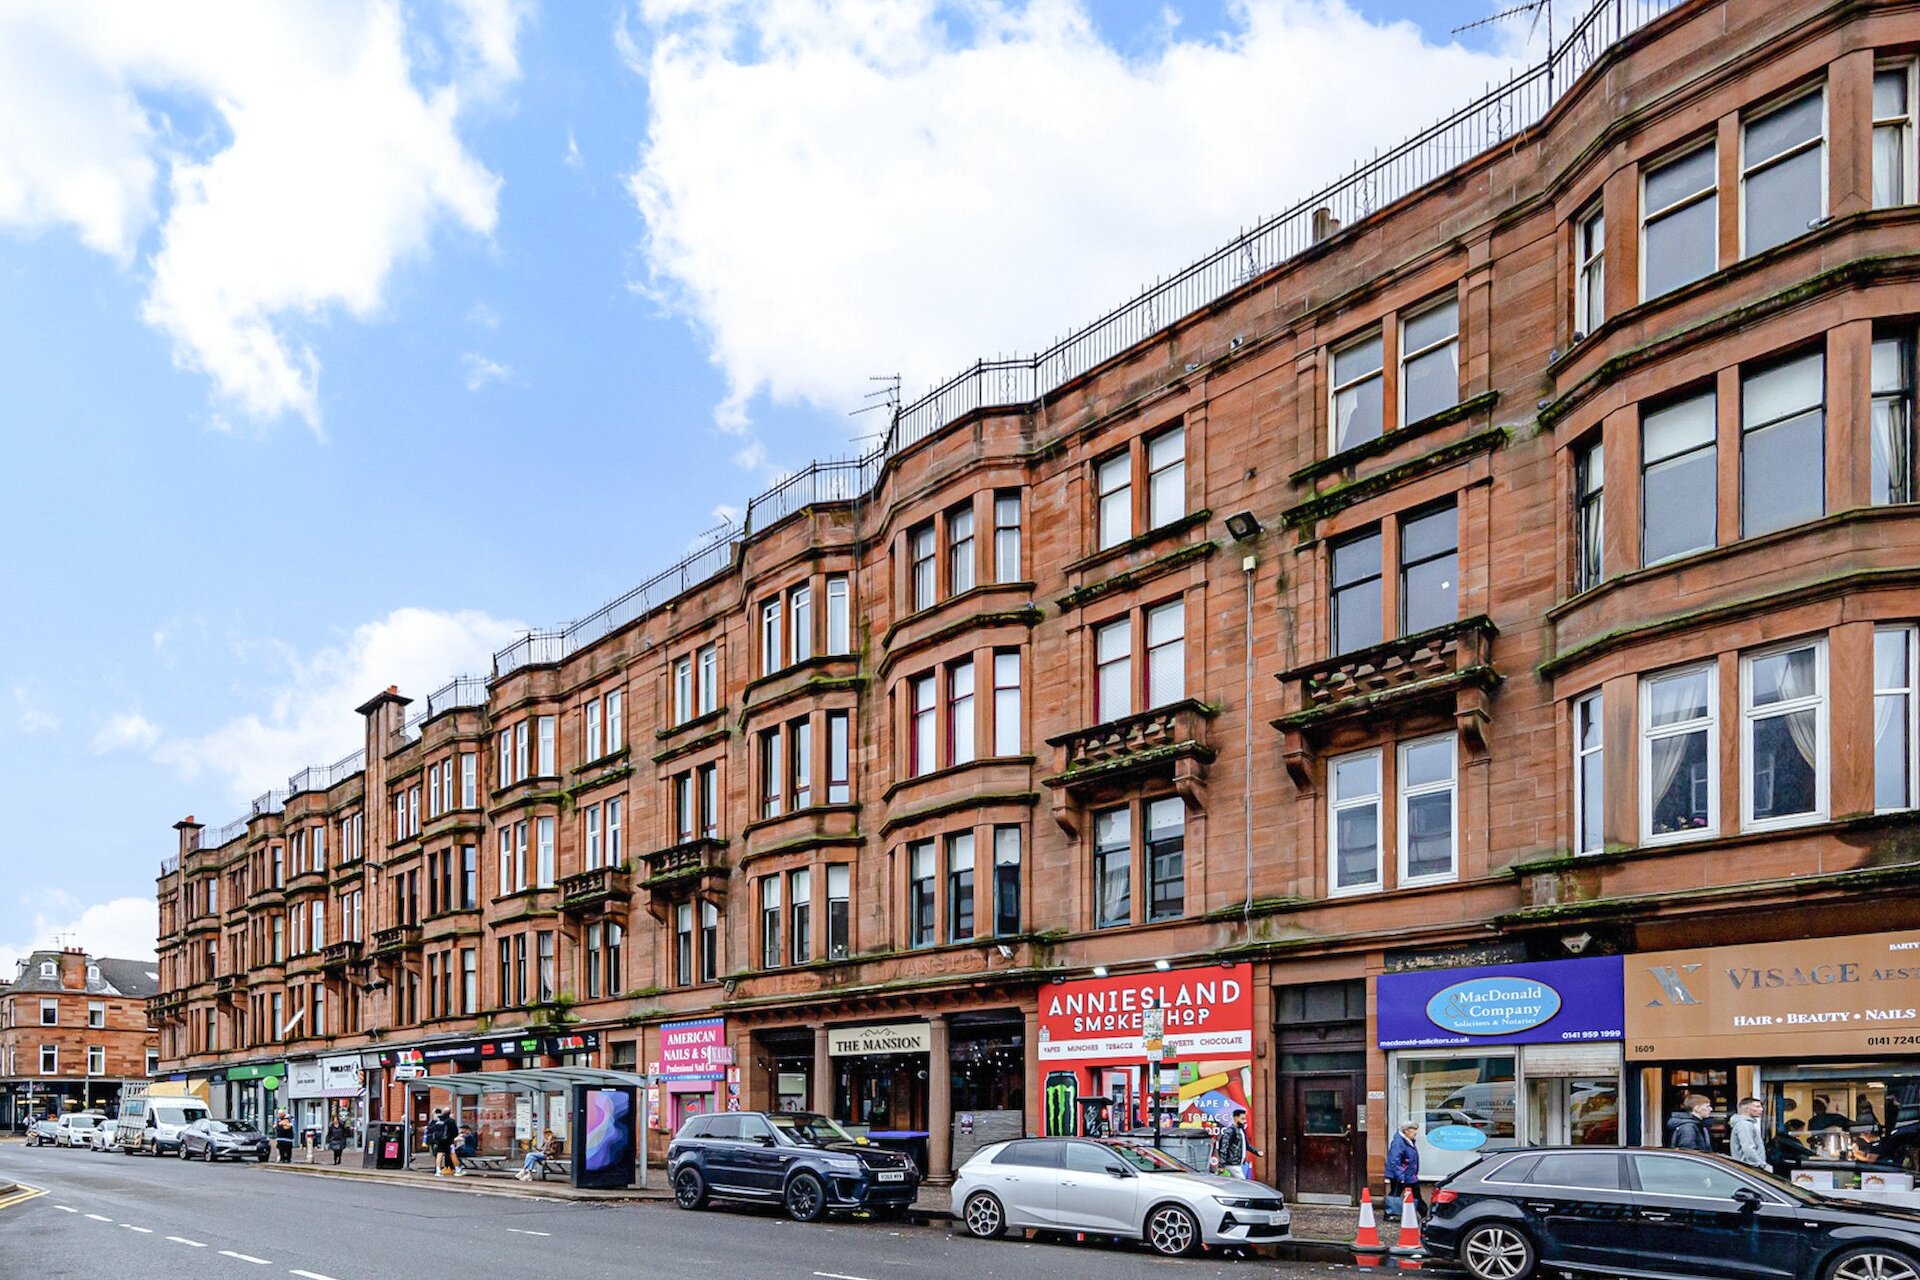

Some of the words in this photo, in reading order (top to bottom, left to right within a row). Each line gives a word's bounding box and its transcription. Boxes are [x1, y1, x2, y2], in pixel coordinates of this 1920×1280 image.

[1726, 963, 1860, 990] VISAGE
[1049, 980, 1241, 1016] ANNIESLAND
[1459, 987, 1542, 1003] MacDonald
[1469, 1005, 1541, 1018] Company
[1733, 1015, 1772, 1026] HAIR
[1786, 1012, 1850, 1024] BEAUTY
[1865, 1009, 1917, 1021] NAILS
[1073, 1013, 1142, 1033] SMOKE
[1167, 1008, 1211, 1026] HOP
[1453, 1020, 1490, 1028] Solicitors
[667, 1030, 716, 1045] AMERICAN
[1199, 1036, 1243, 1045] CHOCOLATE
[1562, 1031, 1581, 1040] 0141
[1582, 1030, 1599, 1039] 959
[1600, 1029, 1621, 1038] 1999
[1867, 1036, 1890, 1046] 0141
[836, 1039, 860, 1053] THE
[862, 1035, 921, 1051] MANSION
[1067, 1044, 1099, 1052] MUNCHIES
[1105, 1042, 1134, 1050] TOBACCO
[1634, 1045, 1655, 1053] 1609
[664, 1048, 690, 1061] NAILS
[691, 1047, 699, 1059] &
[712, 1046, 733, 1062] NAILS
[1194, 1099, 1219, 1108] VAPE
[1223, 1099, 1230, 1108] &
